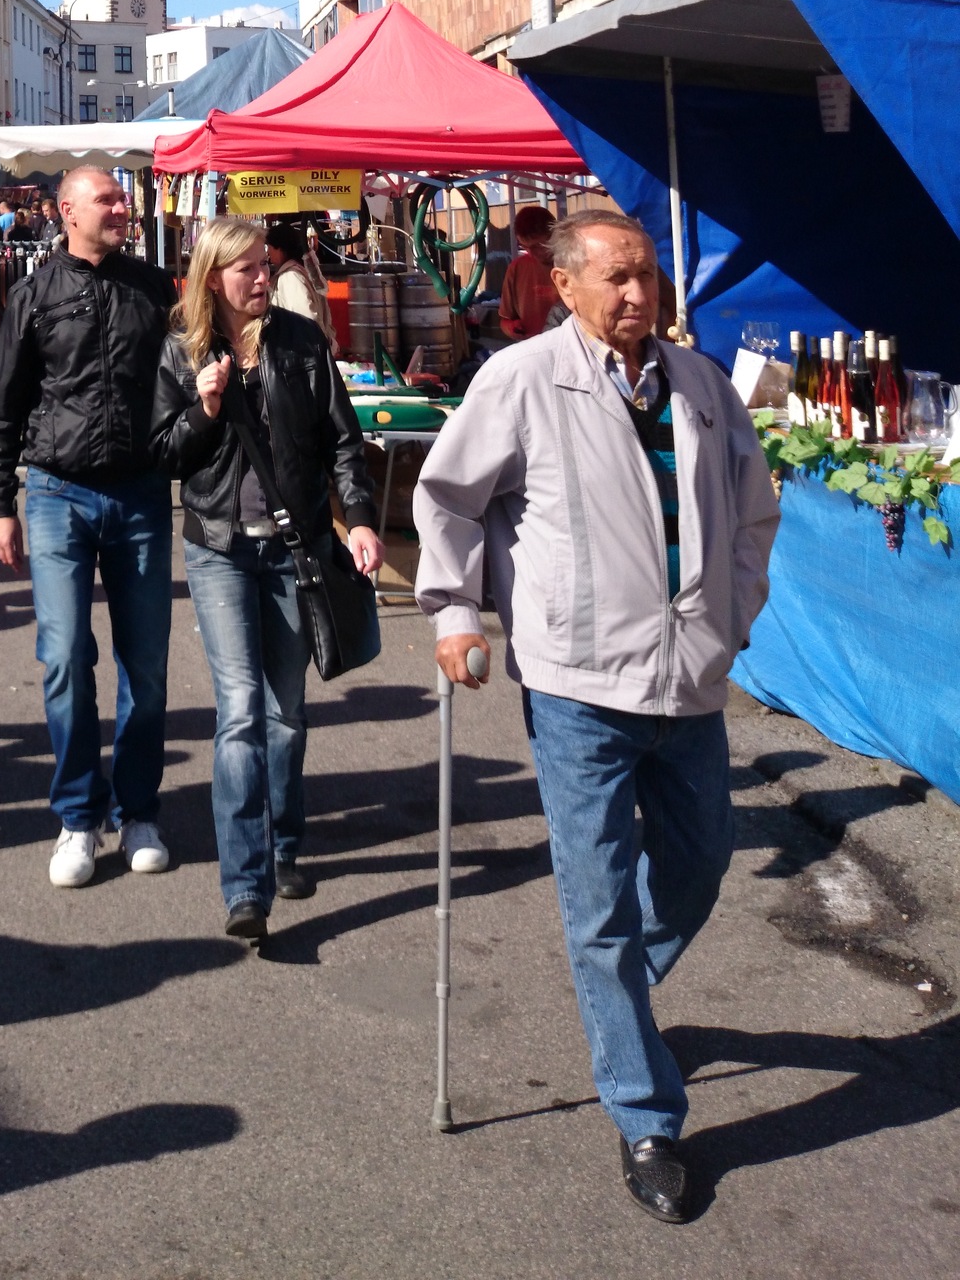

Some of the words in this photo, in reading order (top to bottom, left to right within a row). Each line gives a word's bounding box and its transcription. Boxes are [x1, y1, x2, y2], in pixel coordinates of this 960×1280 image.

[311, 169, 340, 180] DÍLY
[240, 175, 285, 186] SERVIS
[239, 189, 286, 198] VORWERK
[300, 185, 351, 194] VORWERK
